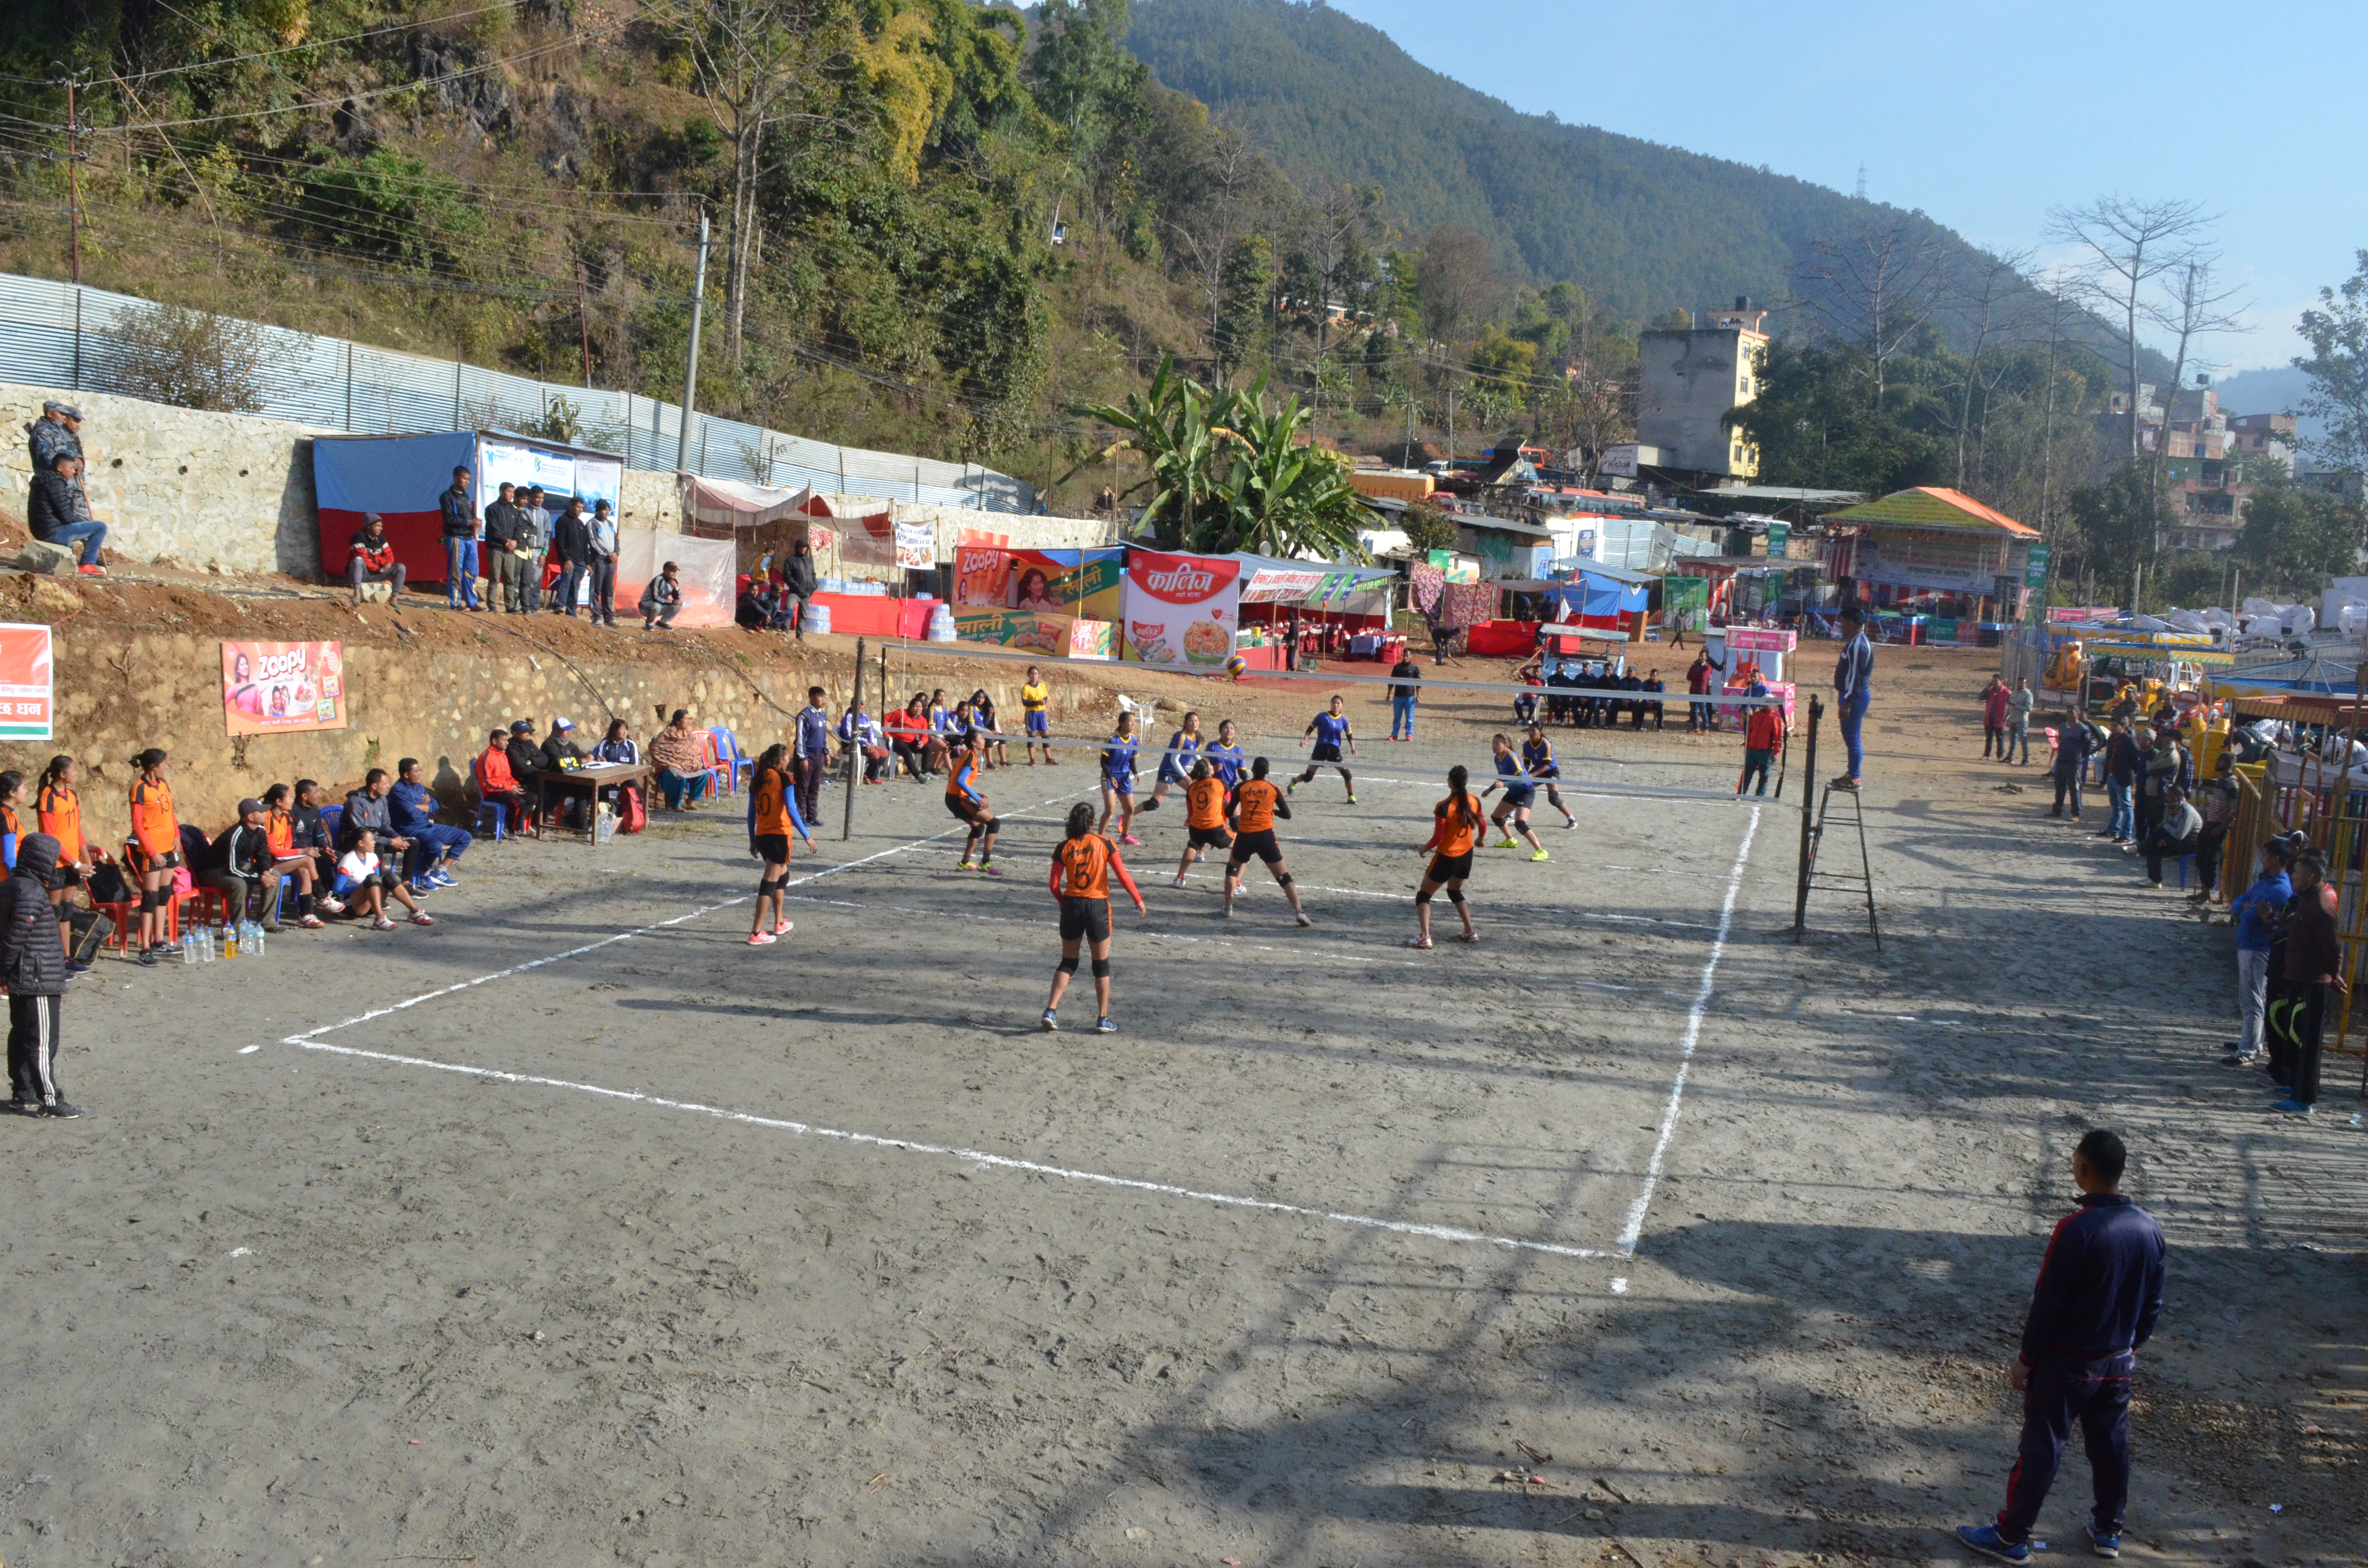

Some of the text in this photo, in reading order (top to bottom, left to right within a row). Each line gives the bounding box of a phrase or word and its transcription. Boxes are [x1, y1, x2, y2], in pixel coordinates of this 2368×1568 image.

[1147, 563, 1215, 591] कालिज
[955, 613, 1005, 635] लाली
[570, 757, 579, 767] 2
[1196, 791, 1208, 810] 9
[1245, 786, 1268, 796] Army
[65, 807, 76, 828] 11
[1247, 800, 1260, 821] 7
[1075, 862, 1090, 890] 5
